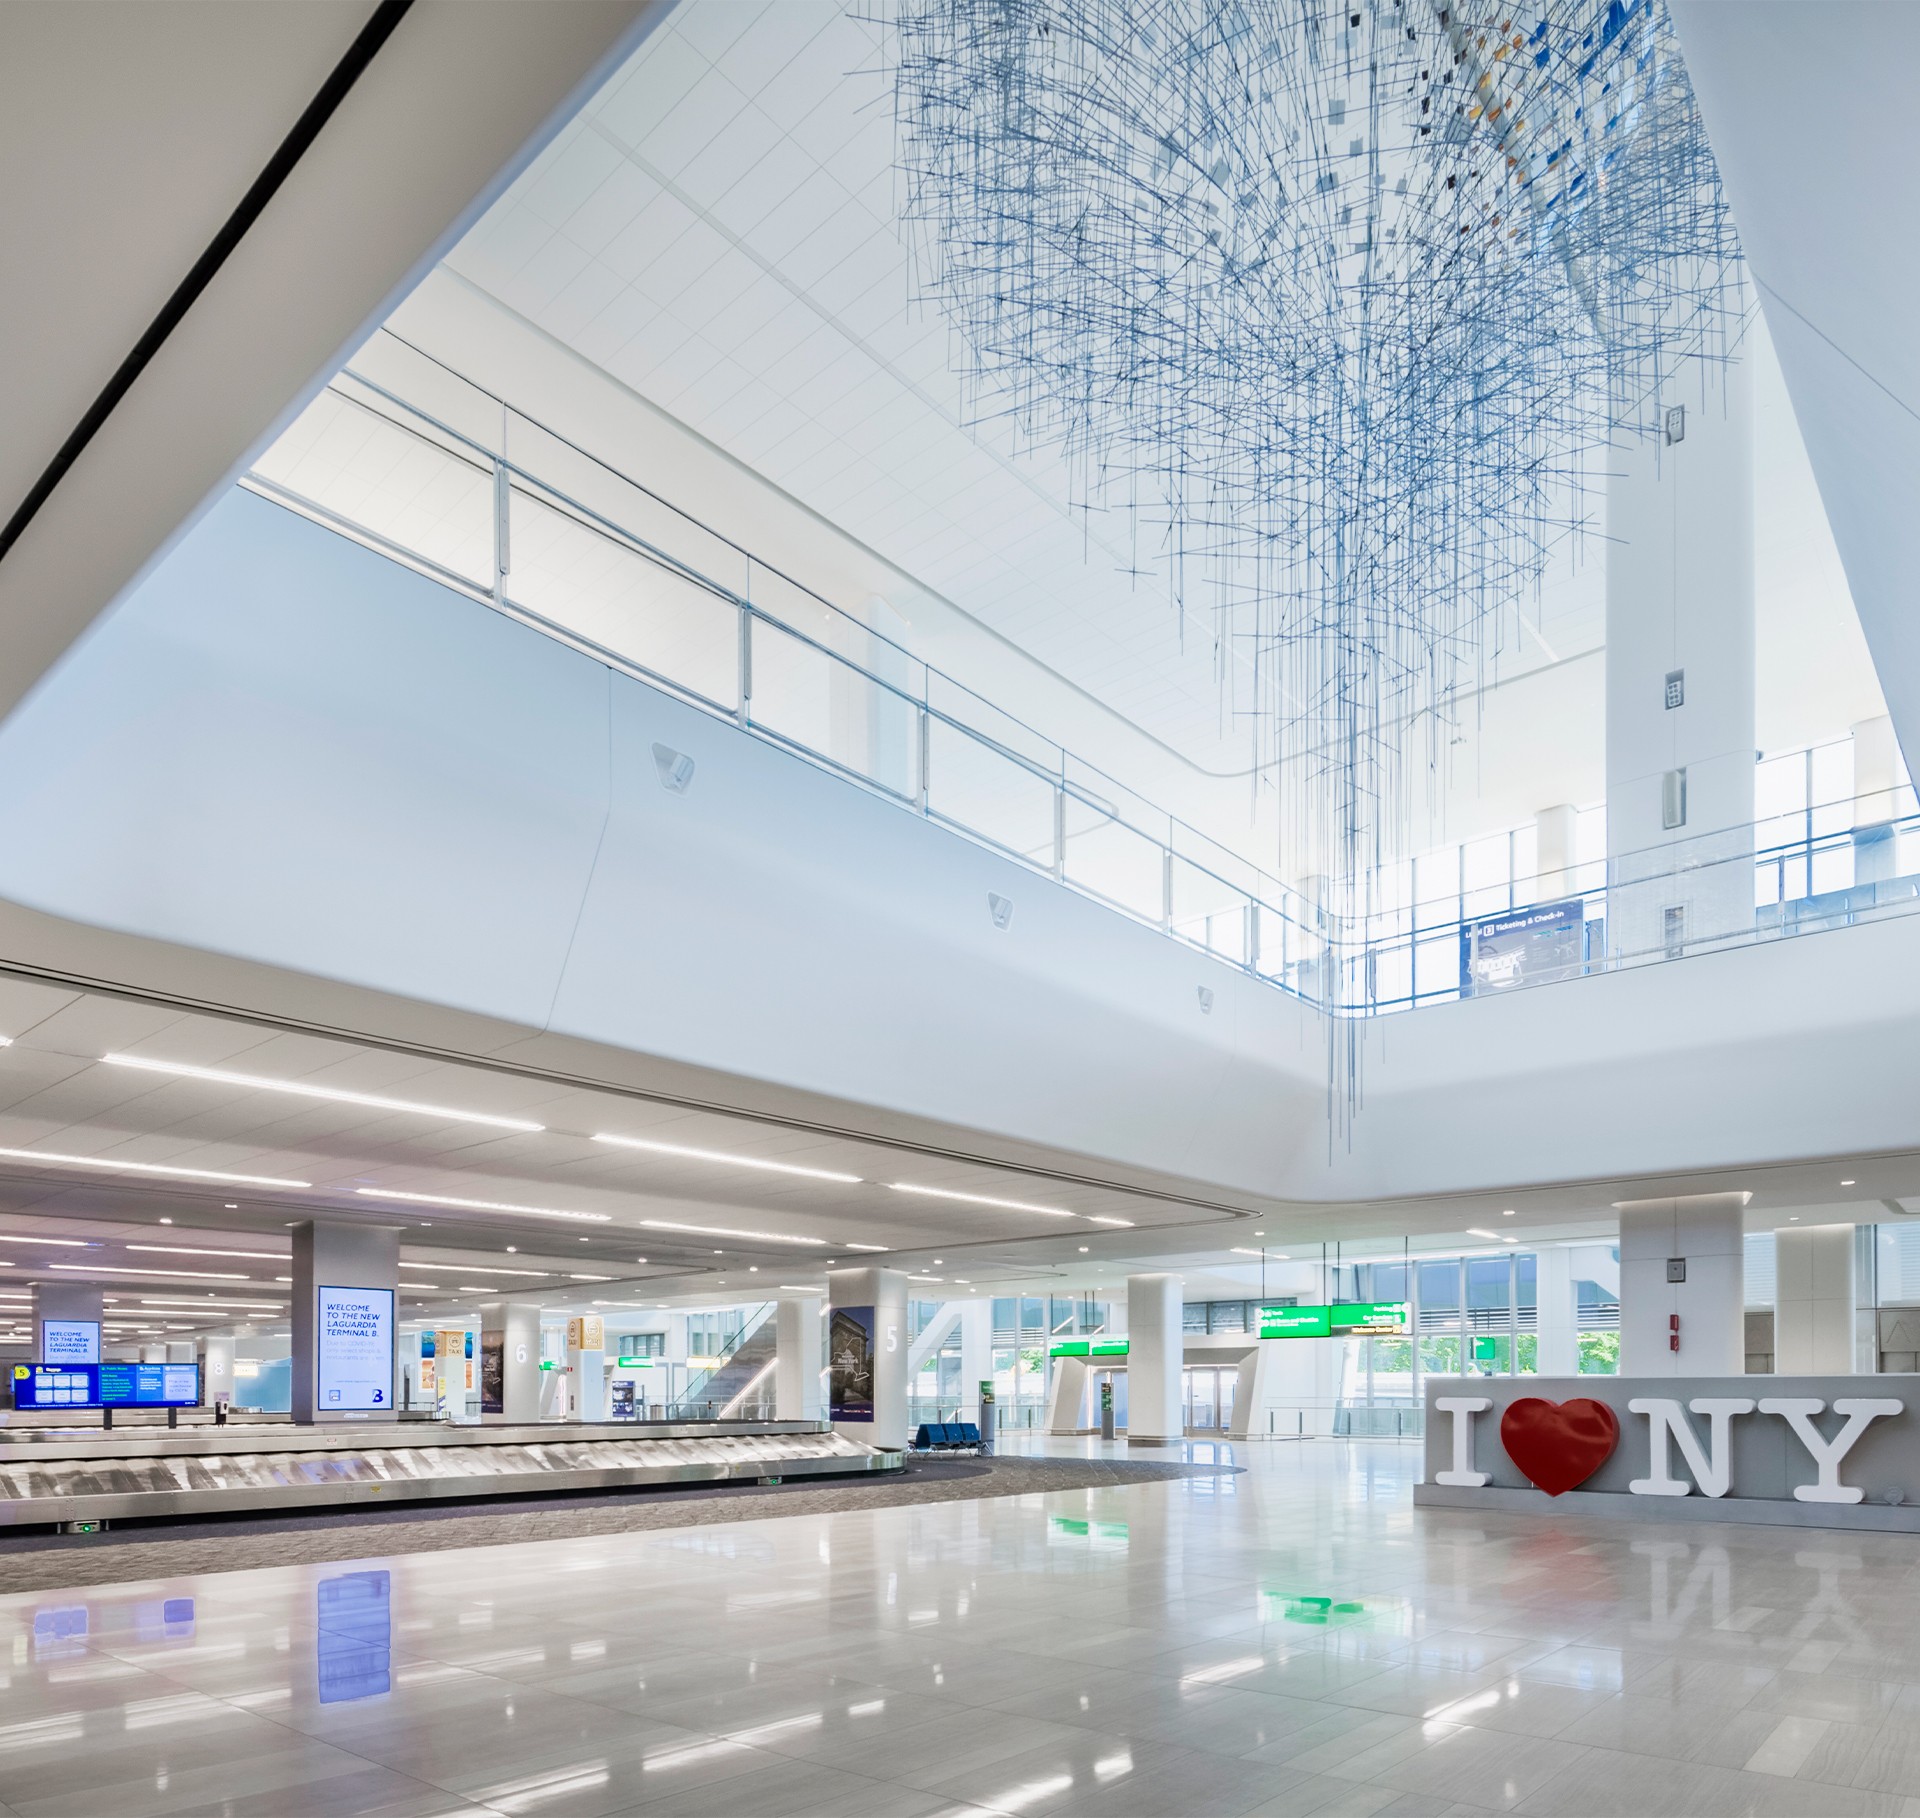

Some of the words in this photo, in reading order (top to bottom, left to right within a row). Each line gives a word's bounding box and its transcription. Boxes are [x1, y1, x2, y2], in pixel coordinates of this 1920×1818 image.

[1496, 920, 1527, 931] Ticketing
[1534, 910, 1565, 922] Check-in
[327, 1303, 370, 1312] WELCOME
[342, 1312, 358, 1320] THE
[327, 1321, 377, 1329] LAGUARDIA
[326, 1329, 369, 1337] TERMINAL
[886, 1325, 898, 1352] 5
[516, 1344, 528, 1363] 6
[19, 1369, 25, 1377] 5
[214, 1362, 224, 1375] 8
[1435, 1397, 1493, 1487] I
[1628, 1399, 1905, 1504] NY
